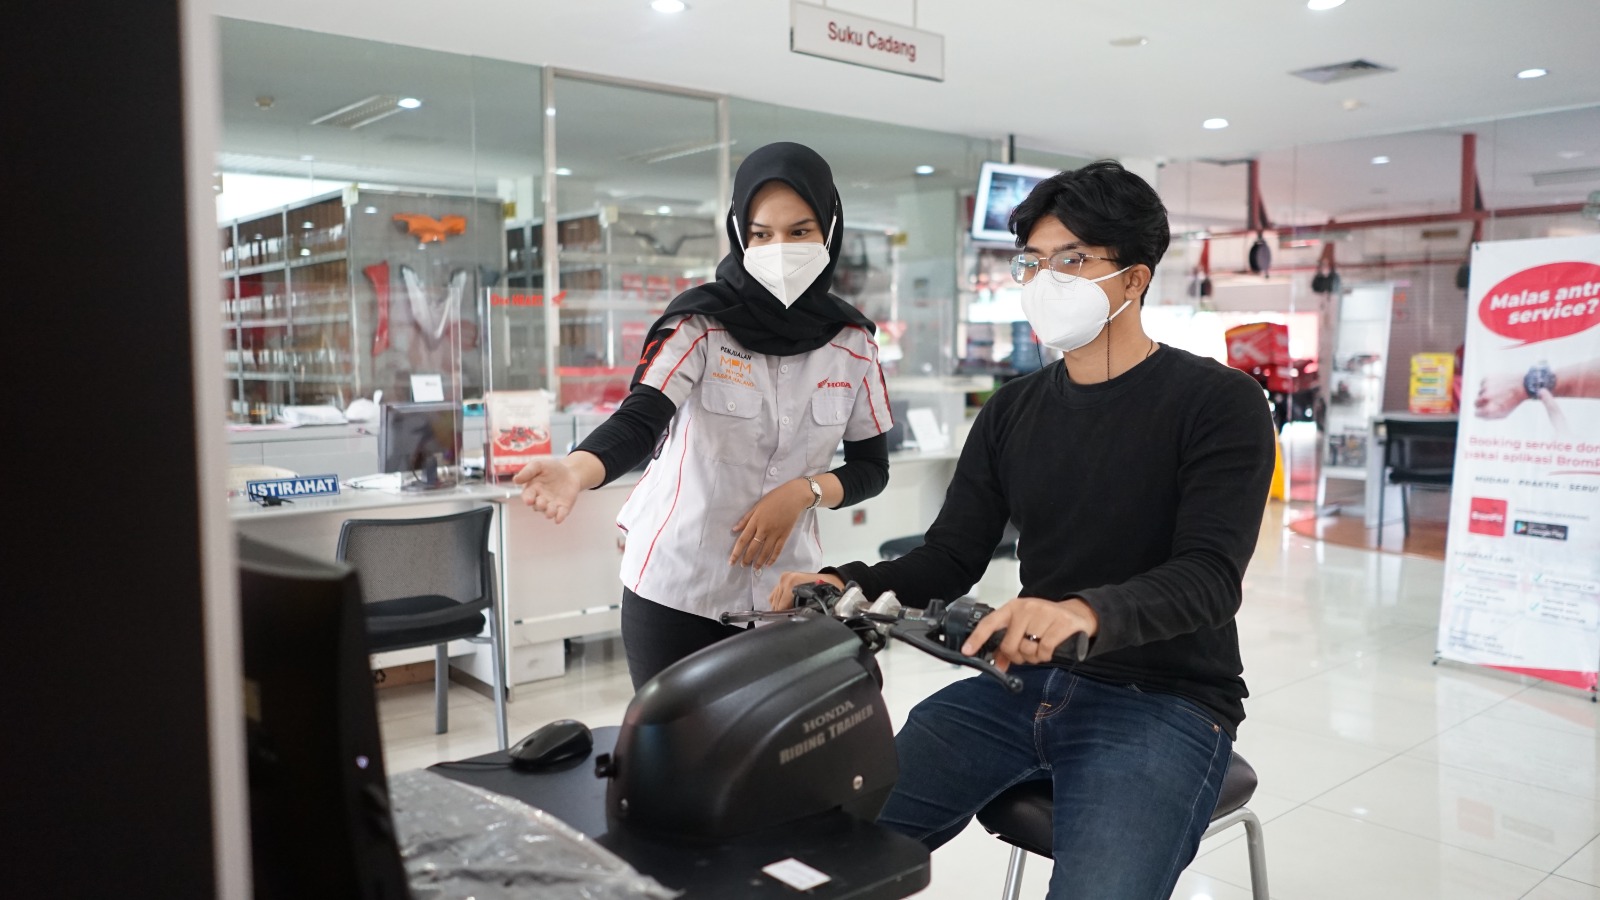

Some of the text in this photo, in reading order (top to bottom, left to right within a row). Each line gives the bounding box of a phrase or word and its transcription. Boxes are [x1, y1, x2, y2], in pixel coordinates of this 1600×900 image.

[827, 21, 917, 62] Suku Cadang
[1490, 289, 1551, 311] Malas
[1507, 298, 1599, 325] service?
[720, 345, 752, 361] PENJUALAN
[1469, 436, 1521, 450] Booking
[1525, 439, 1573, 452] service
[1503, 452, 1553, 464] aplikasi
[251, 478, 335, 496] ISTIRAHAT
[1518, 479, 1560, 489] PRAKTIS
[802, 700, 855, 734] HONDA
[779, 703, 874, 766] RIDING TRAINER
